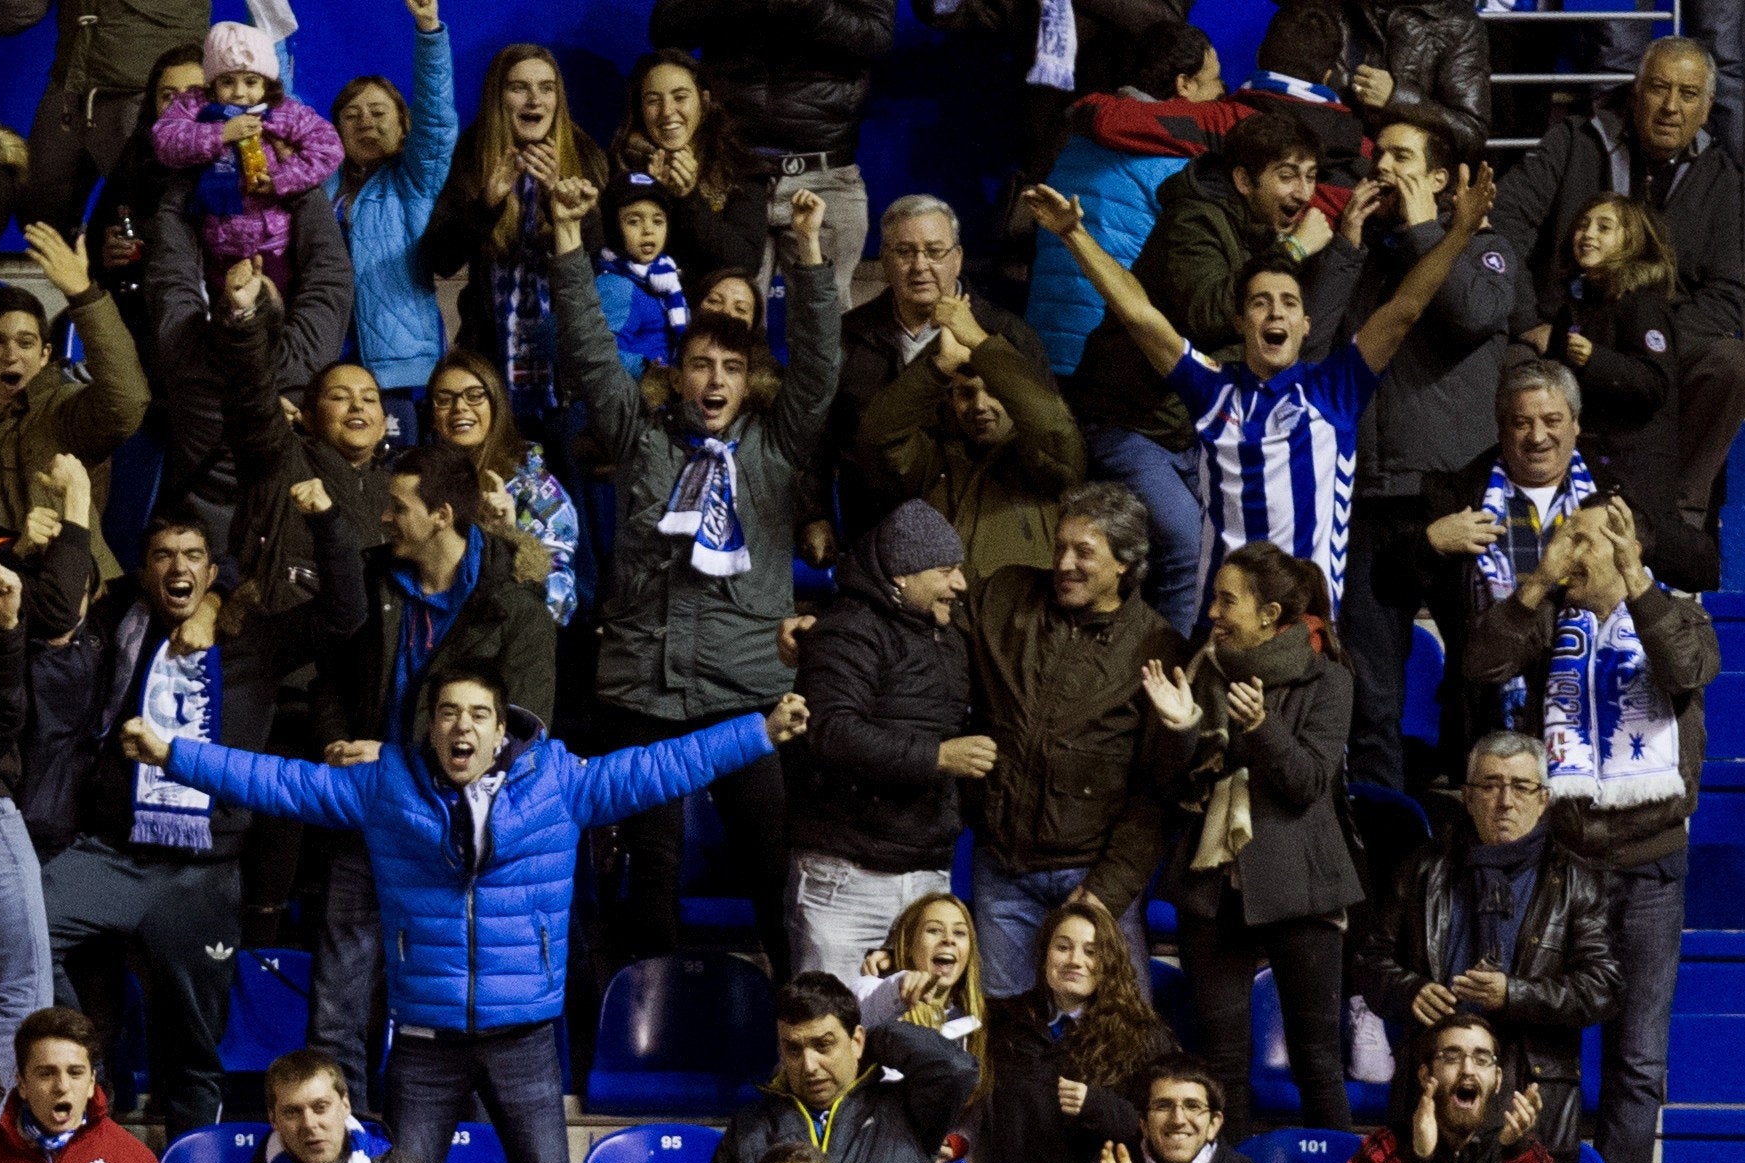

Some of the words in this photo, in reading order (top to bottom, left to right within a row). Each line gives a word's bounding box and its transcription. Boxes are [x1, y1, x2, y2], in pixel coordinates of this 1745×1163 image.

[1545, 668, 1582, 728] 1921
[235, 1133, 254, 1147] 91
[660, 1135, 683, 1150] 95
[1298, 1139, 1328, 1154] 101
